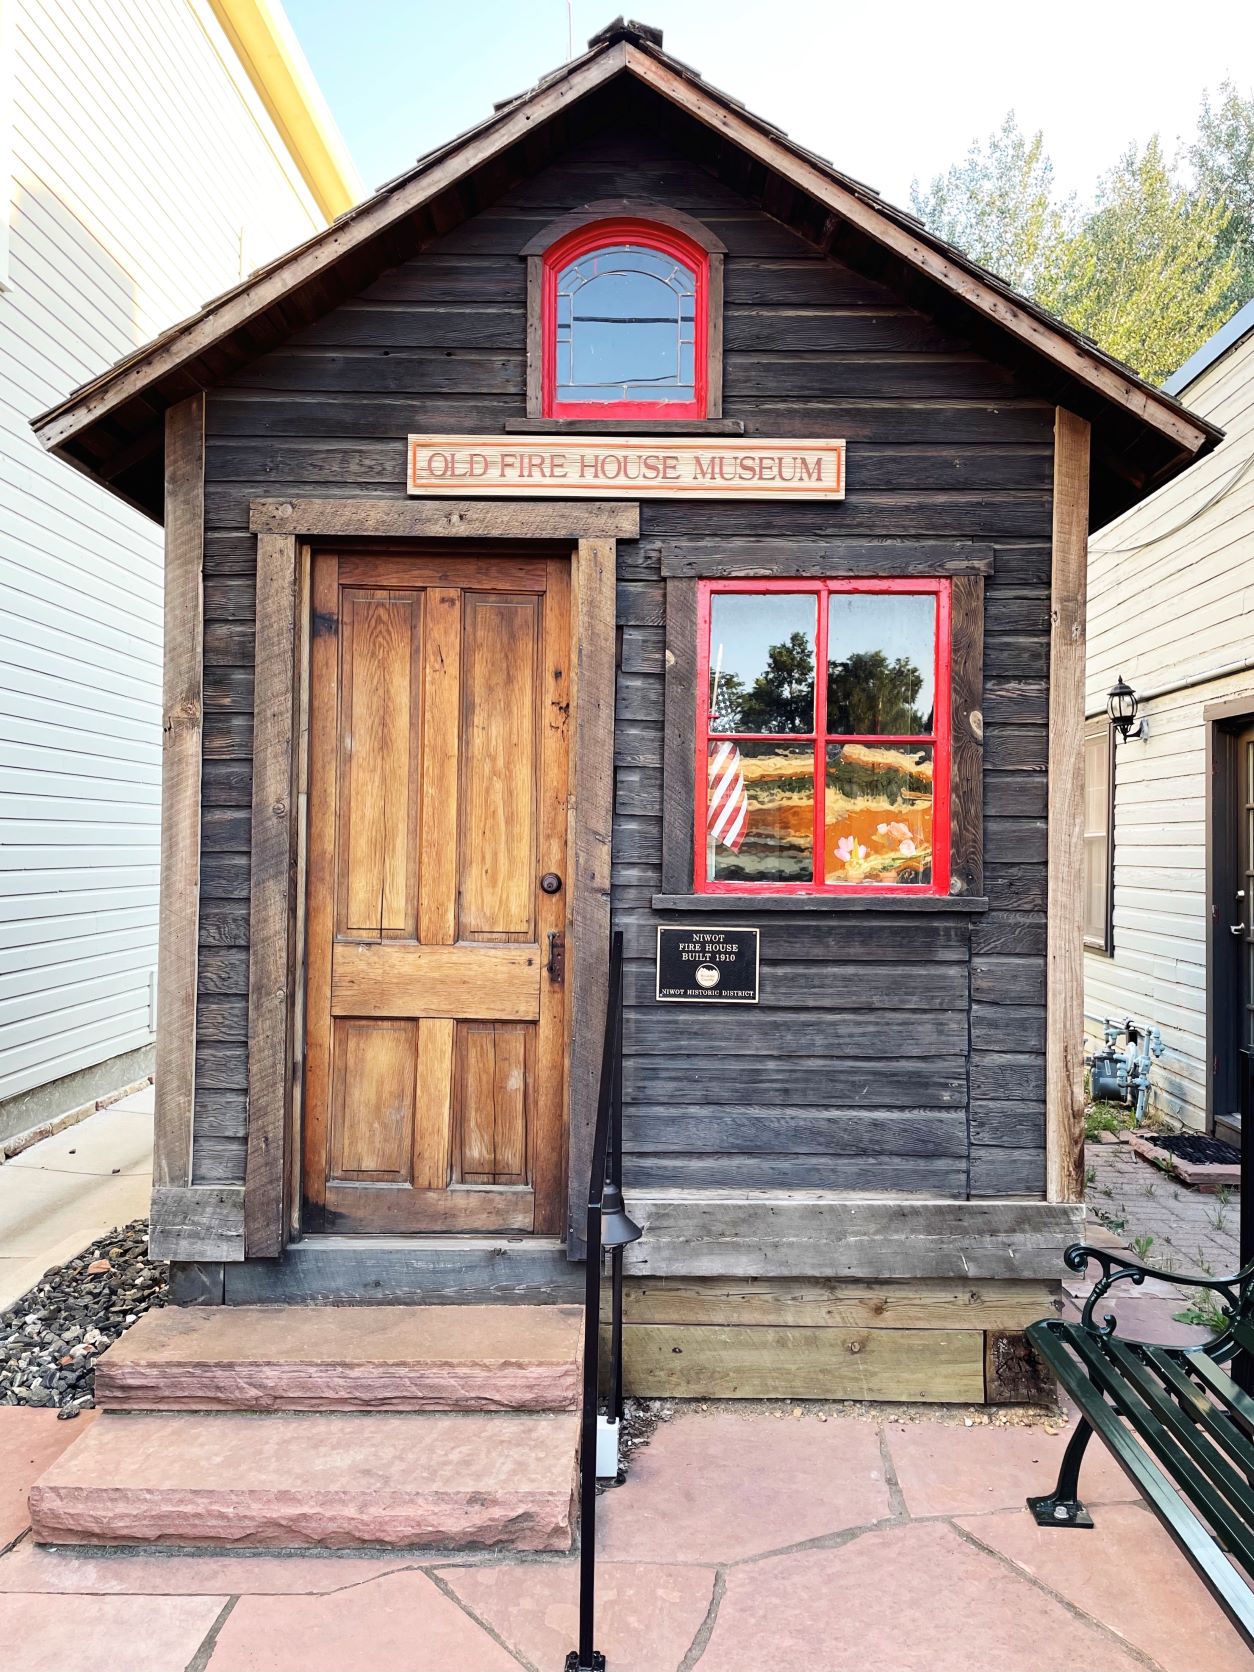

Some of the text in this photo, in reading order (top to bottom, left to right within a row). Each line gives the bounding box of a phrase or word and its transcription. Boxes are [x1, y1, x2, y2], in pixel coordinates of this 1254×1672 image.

[427, 453, 823, 481] OLD FIRE HOUSE MUSEUM
[679, 943, 701, 951] FIRE
